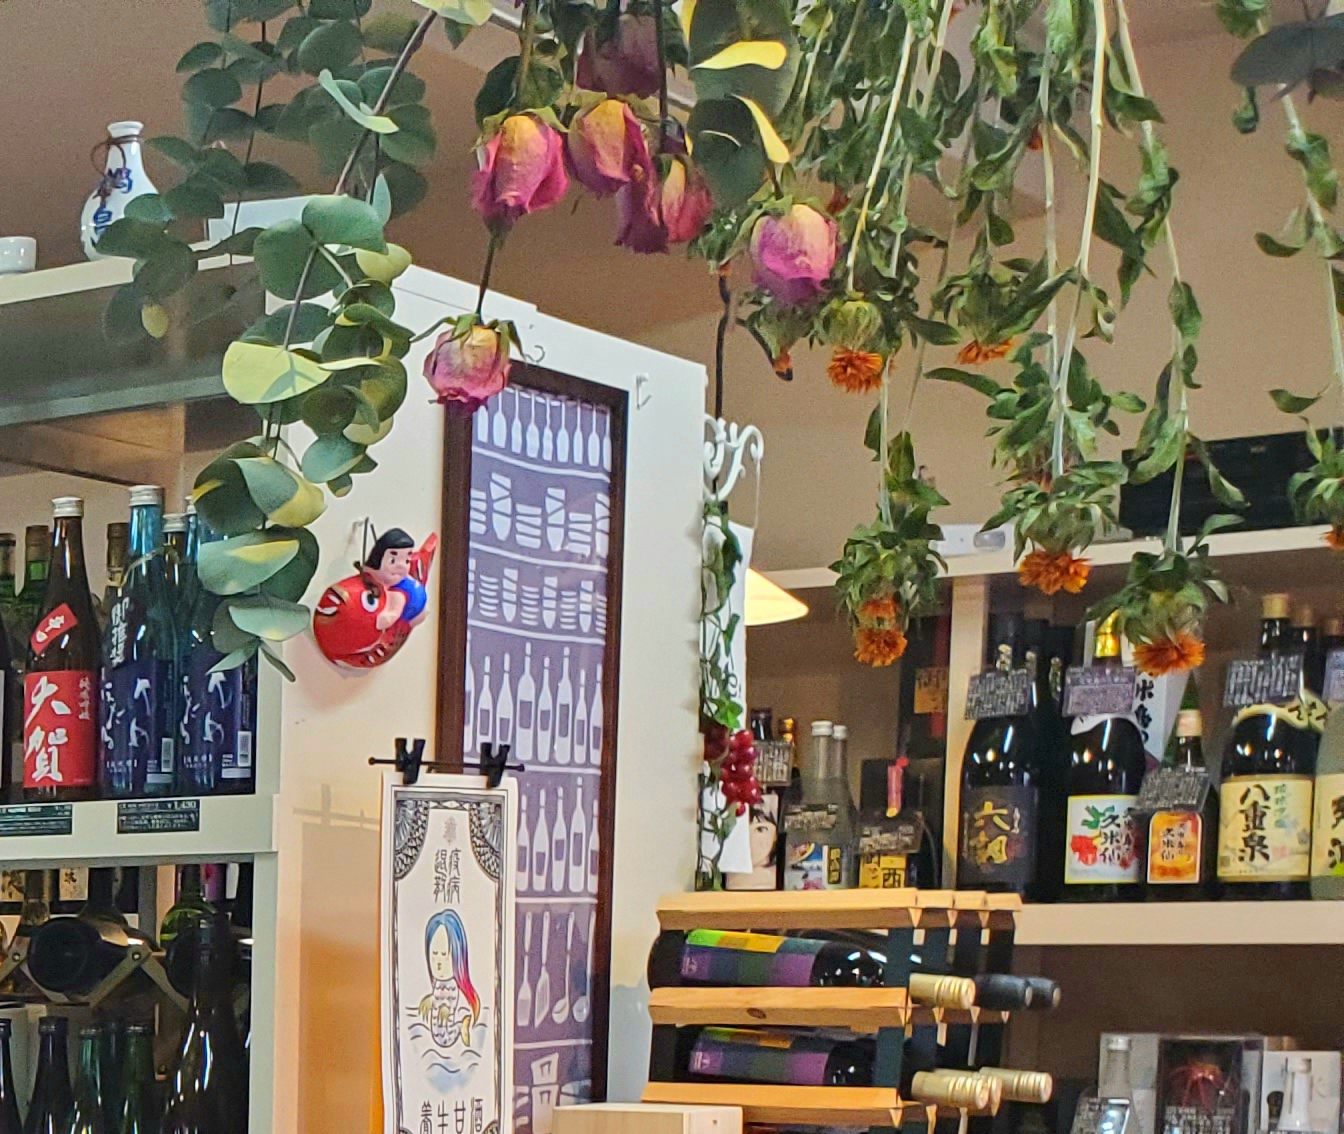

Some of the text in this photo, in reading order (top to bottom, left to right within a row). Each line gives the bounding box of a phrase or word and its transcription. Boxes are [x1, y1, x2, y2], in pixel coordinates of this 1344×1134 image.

[24, 676, 71, 783] 大賀
[1238, 783, 1270, 864] 八重泉
